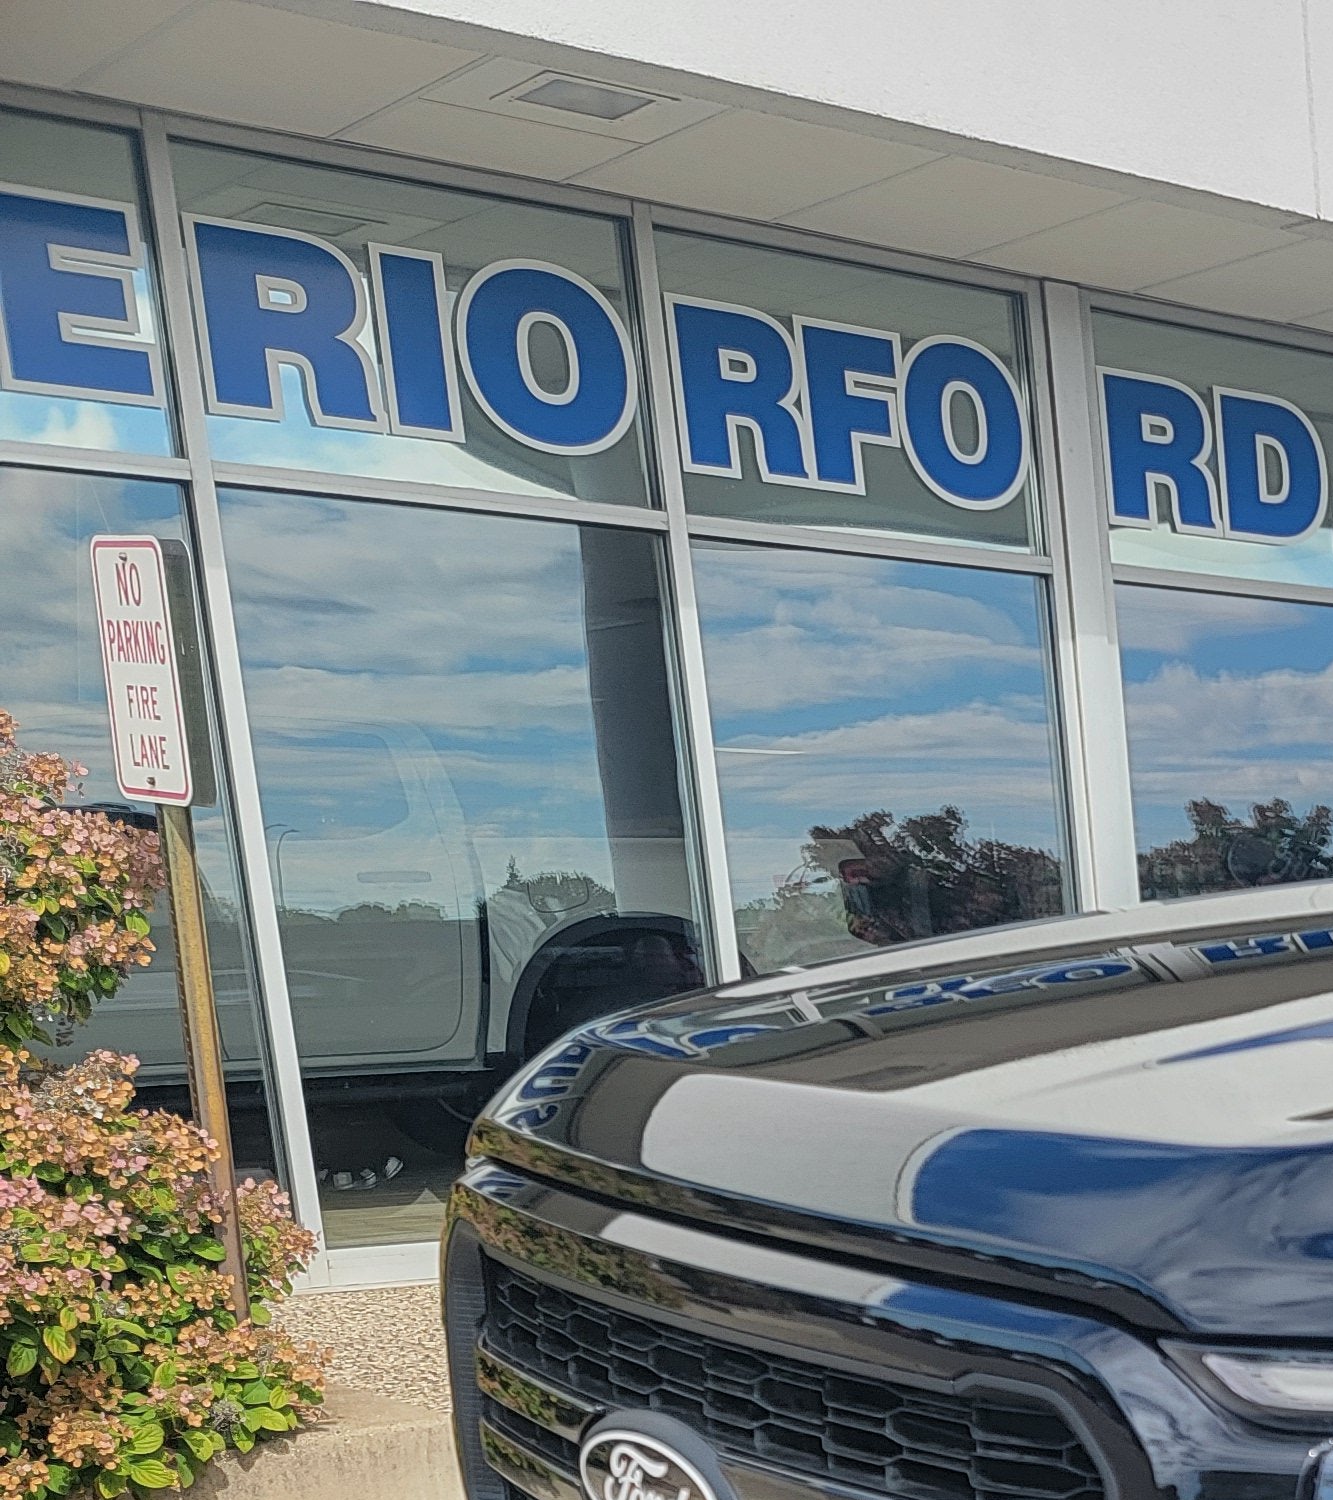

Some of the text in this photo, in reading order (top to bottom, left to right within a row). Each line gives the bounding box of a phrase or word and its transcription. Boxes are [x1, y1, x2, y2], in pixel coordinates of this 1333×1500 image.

[115, 562, 142, 606] NO
[107, 619, 165, 665] PARKING
[126, 684, 161, 721] FIRE
[129, 733, 170, 770] LANE
